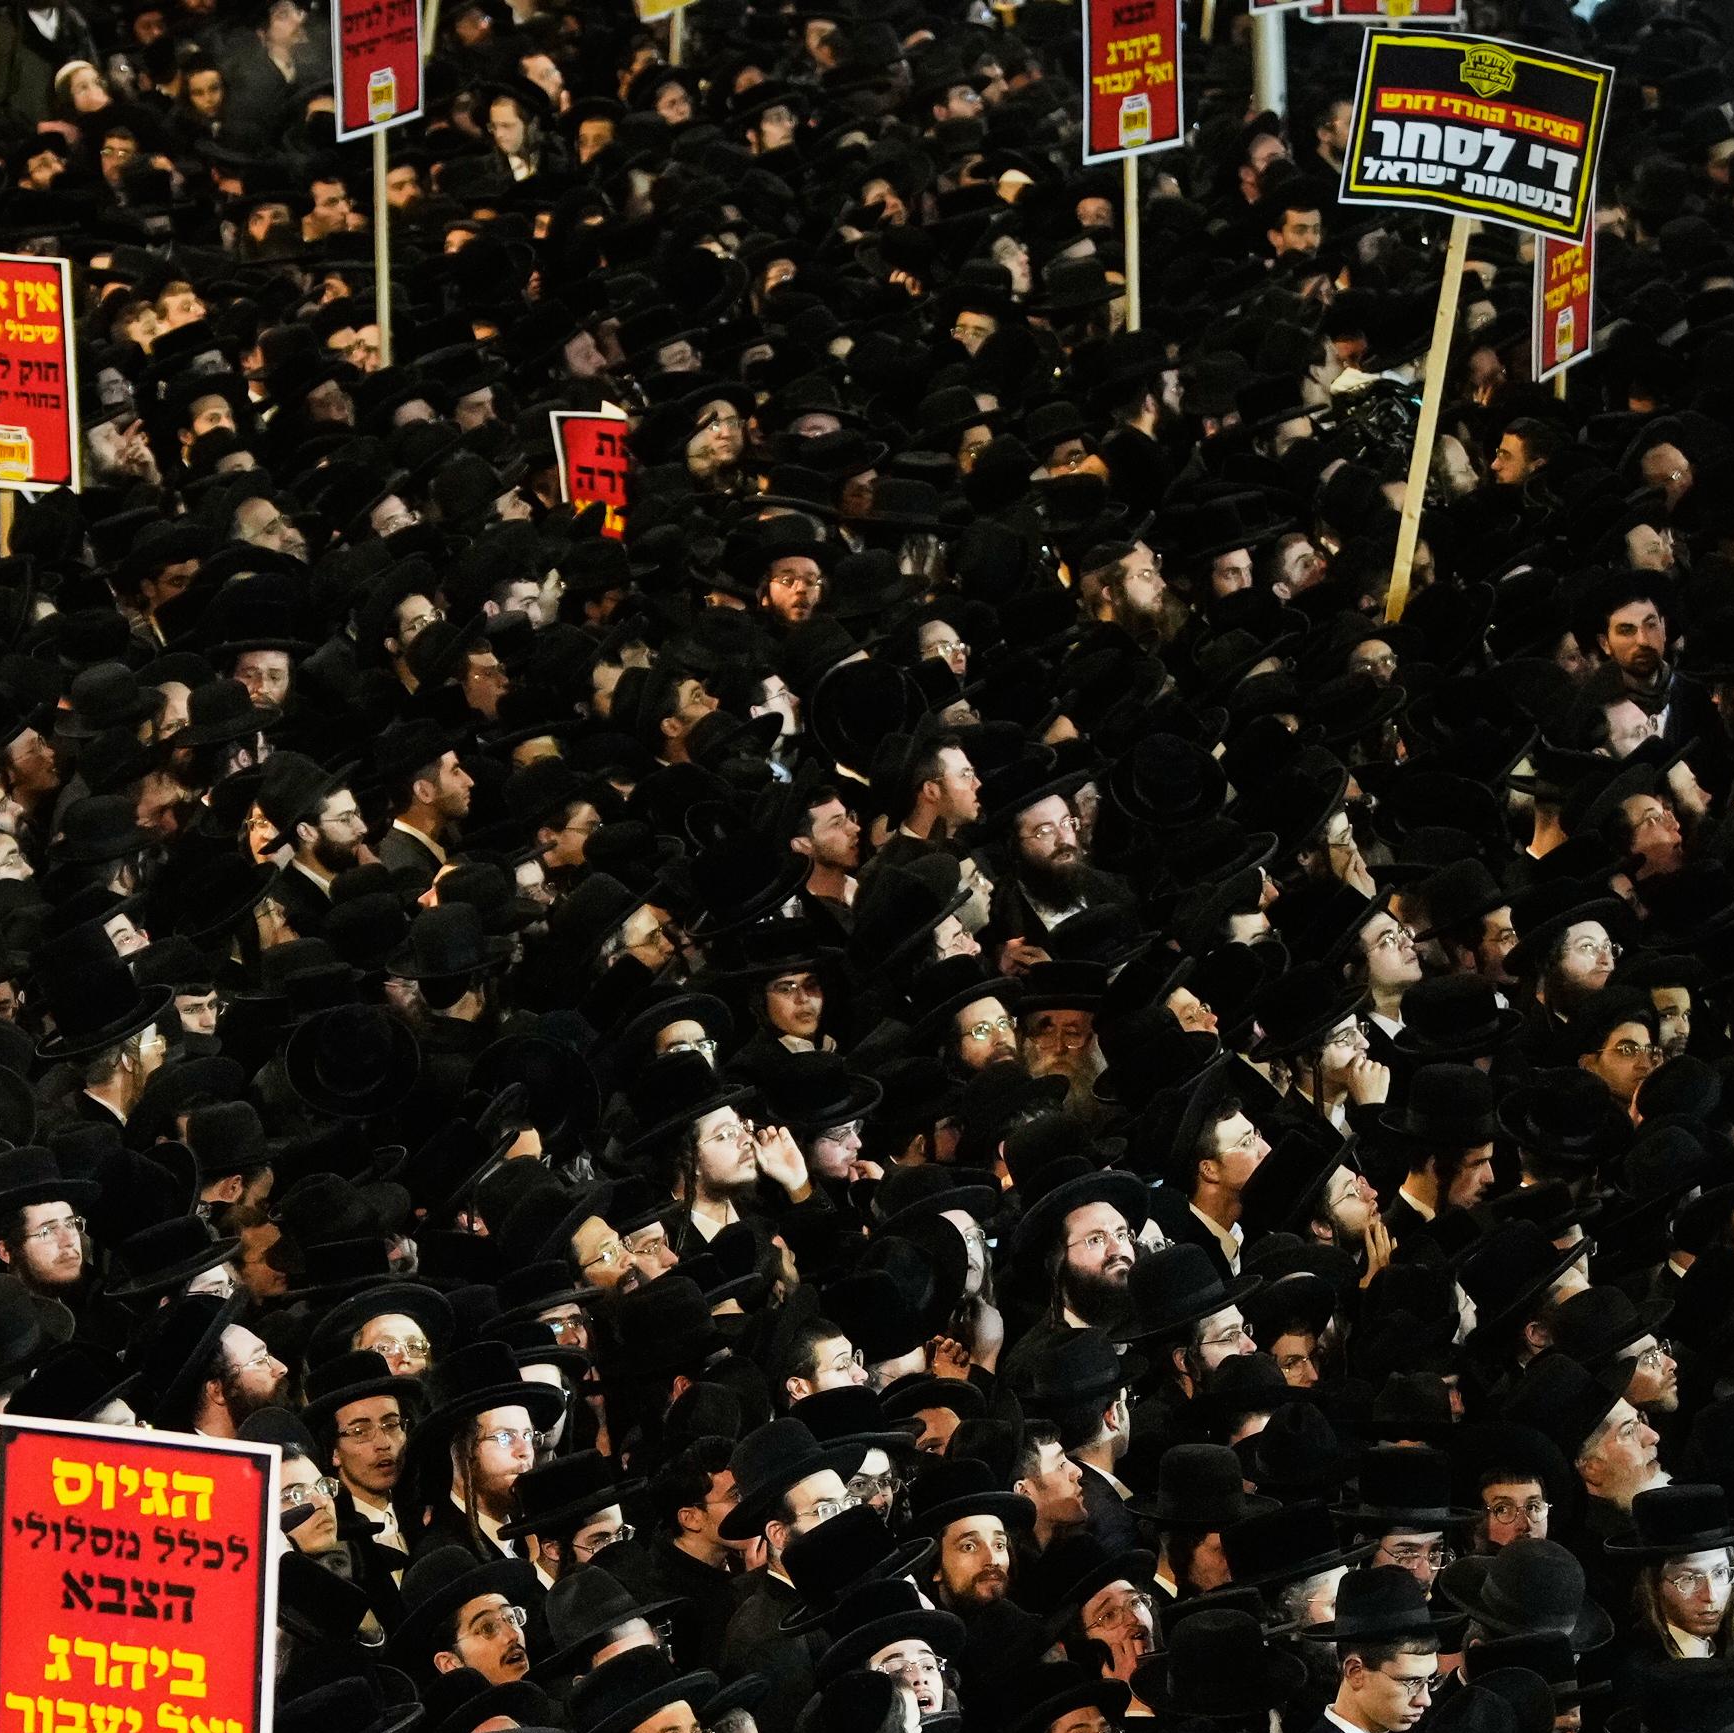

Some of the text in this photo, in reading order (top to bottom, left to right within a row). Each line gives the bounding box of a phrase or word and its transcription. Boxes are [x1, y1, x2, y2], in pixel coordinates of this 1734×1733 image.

[1107, 33, 1162, 65] ביהרג
[1092, 61, 1175, 95] ואל יעבור
[1380, 92, 1579, 142] הציבור החרדי דורש
[1371, 119, 1580, 192] די לסחר
[1362, 156, 1572, 218] בנשמות ישראל
[14, 280, 58, 319] אין
[5, 319, 59, 344] שיכול
[19, 358, 59, 385] חוק
[13, 389, 61, 409] בחורי
[51, 1457, 215, 1521] הגיוס
[11, 1511, 249, 1572] לכלל מסלולי
[60, 1570, 195, 1623] הצבא
[44, 1633, 207, 1699] ביהרג
